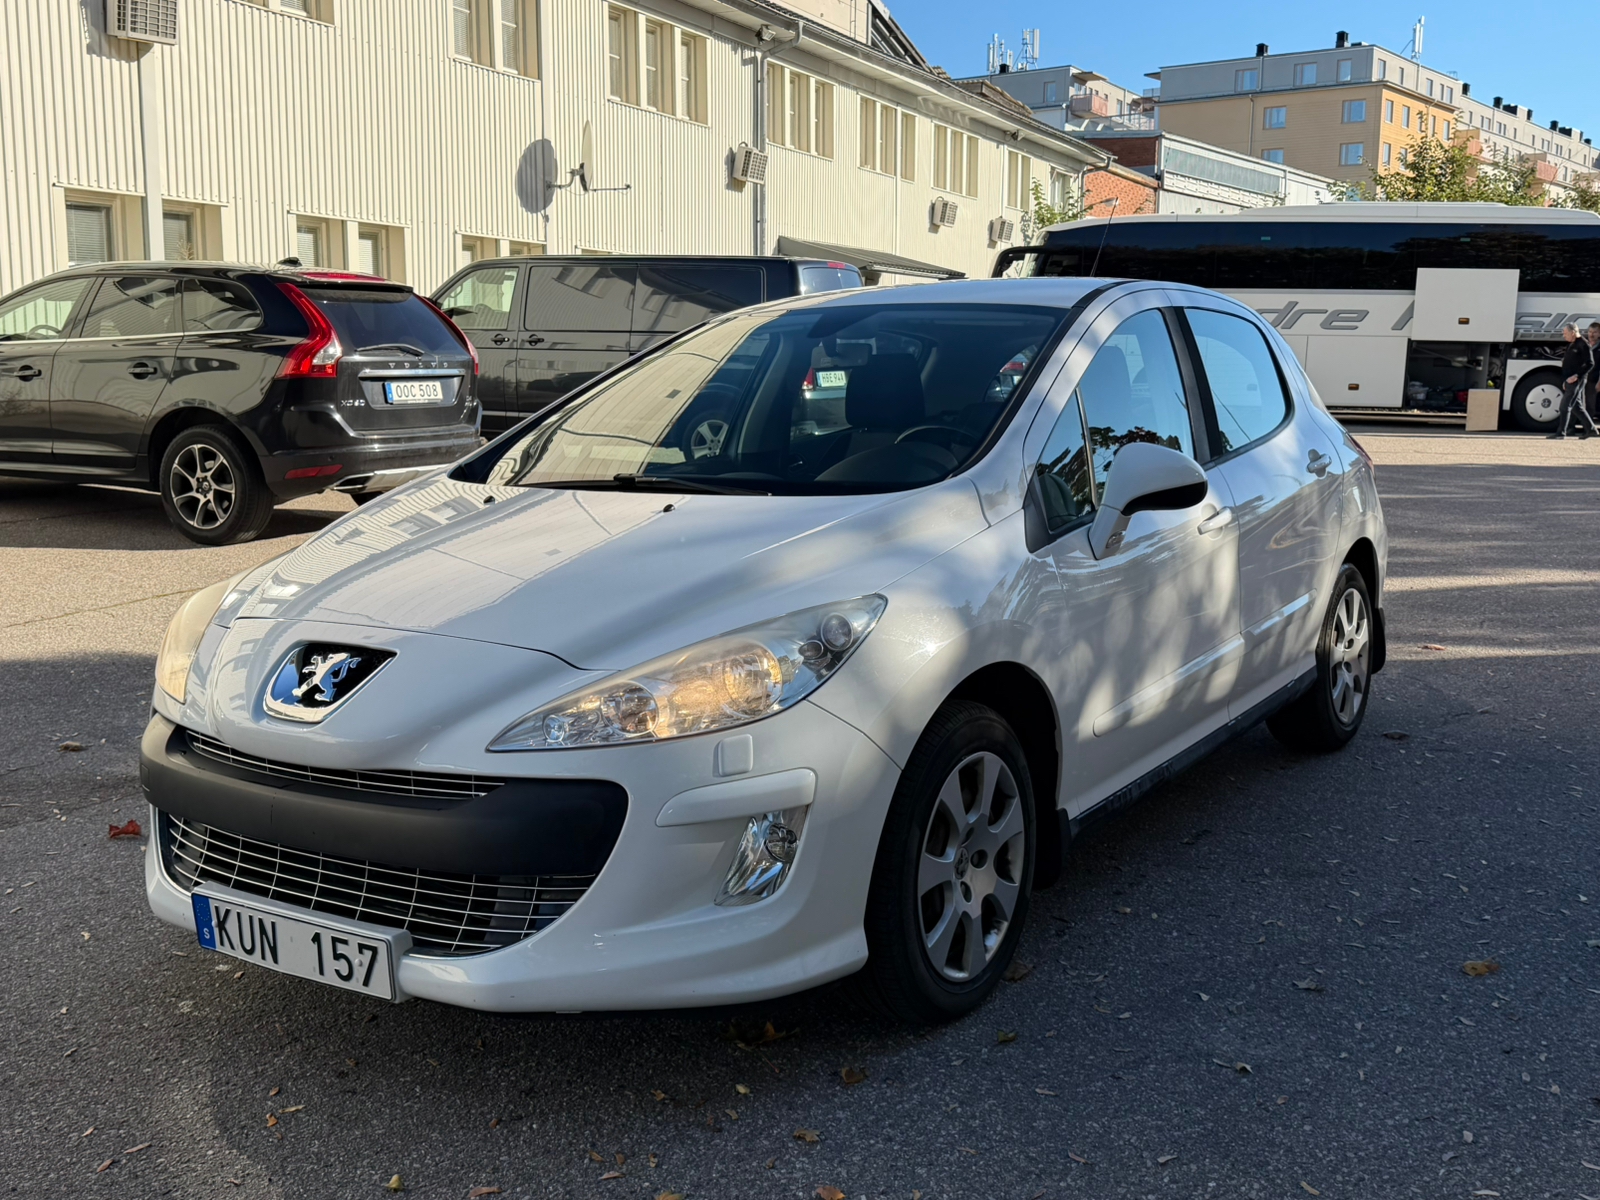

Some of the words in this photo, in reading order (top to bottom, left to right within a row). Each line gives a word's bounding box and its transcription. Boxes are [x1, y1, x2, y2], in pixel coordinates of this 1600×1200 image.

[395, 384, 417, 398] OOC
[419, 384, 439, 398] 508
[340, 399, 366, 407] XC60
[203, 927, 211, 940] S
[214, 905, 279, 965] KUN
[311, 931, 378, 987] 157
